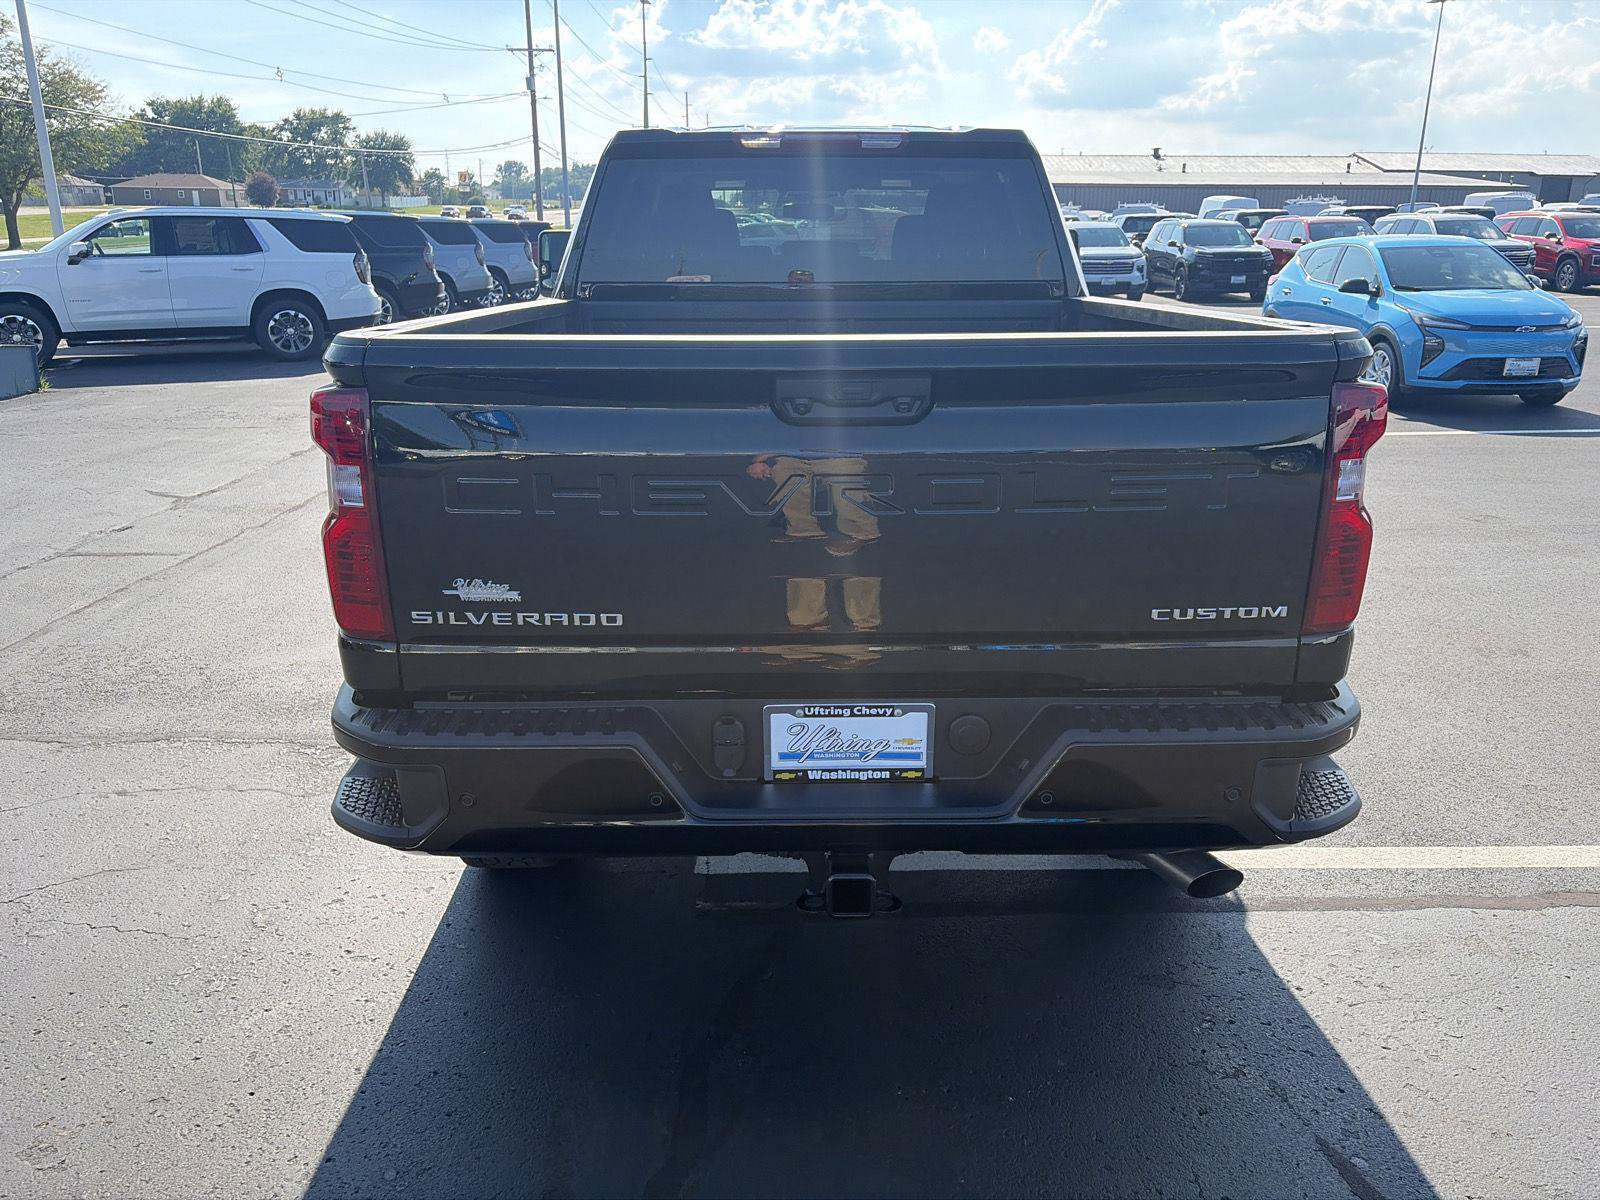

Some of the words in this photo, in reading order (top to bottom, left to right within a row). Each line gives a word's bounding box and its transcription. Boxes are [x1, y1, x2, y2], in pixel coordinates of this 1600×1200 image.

[442, 470, 1260, 516] CHEVROLET
[411, 611, 624, 626] SILVERADO
[1151, 606, 1288, 620] CUSTOM
[804, 706, 851, 716] Uftring
[853, 706, 894, 716] Chevy
[786, 722, 891, 763] Uftring
[807, 770, 890, 781] Washington
